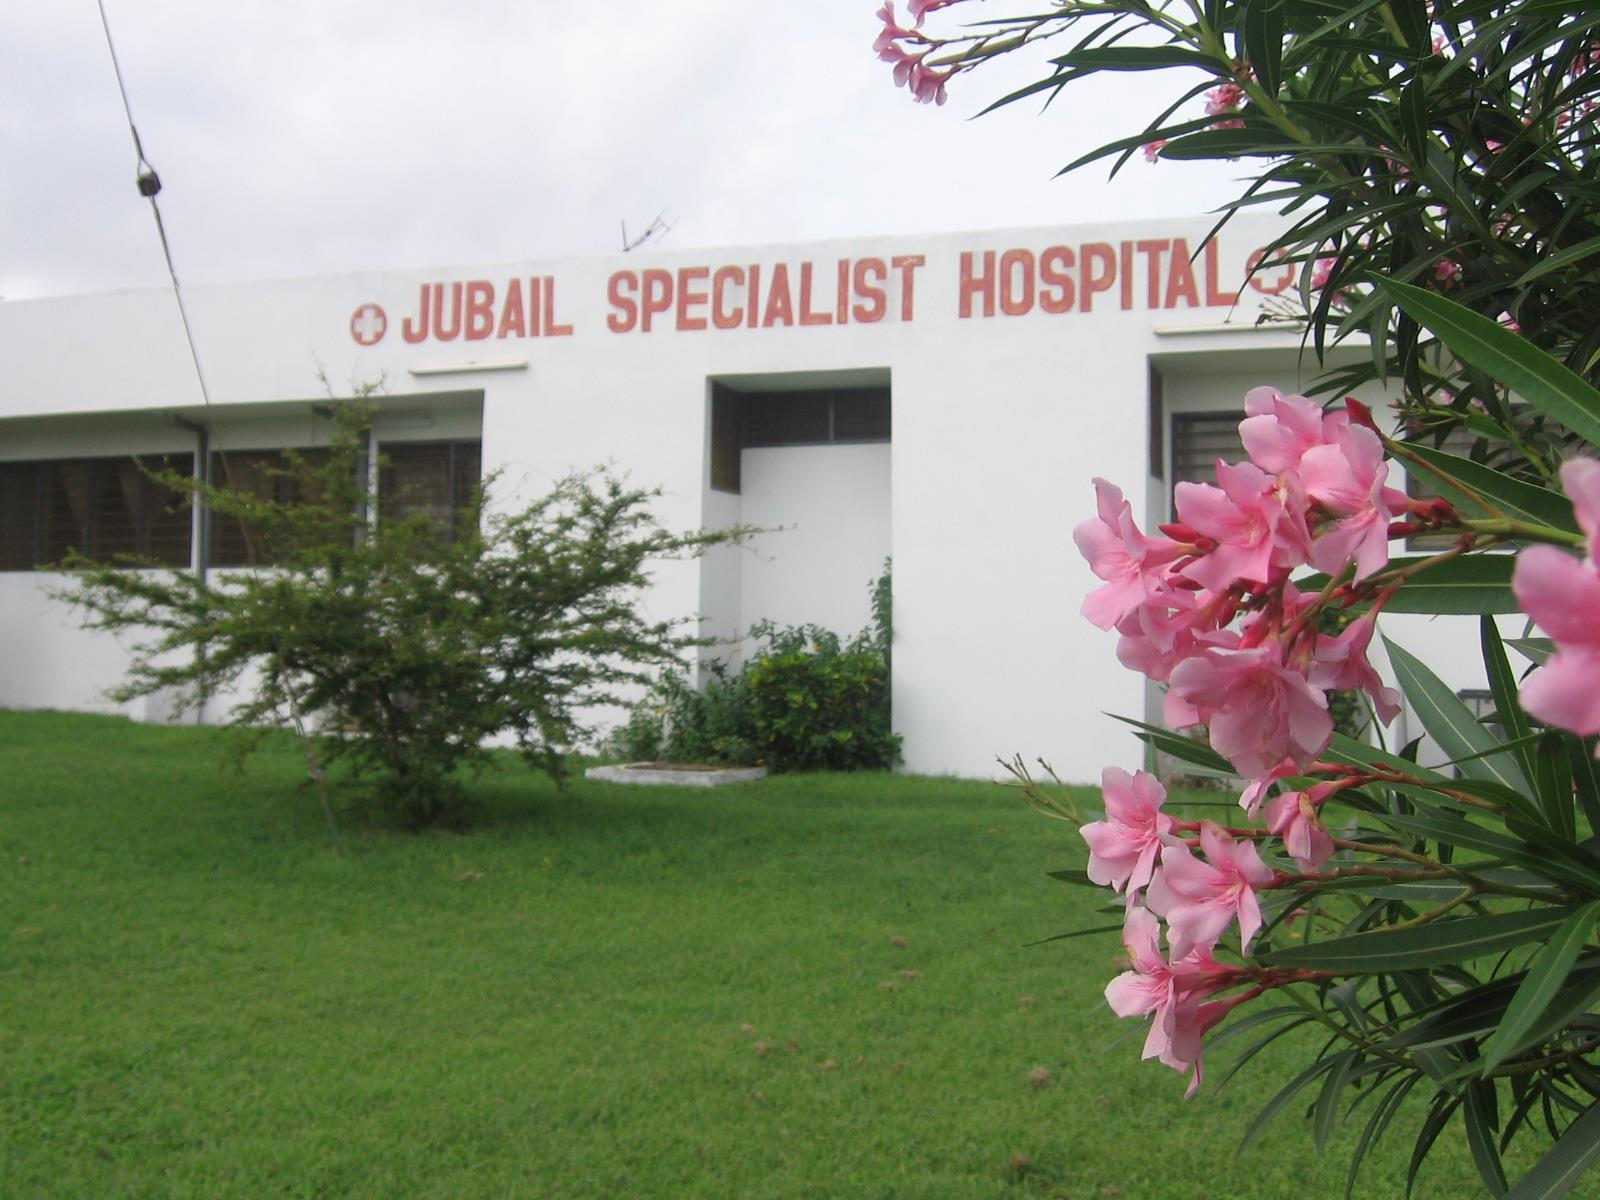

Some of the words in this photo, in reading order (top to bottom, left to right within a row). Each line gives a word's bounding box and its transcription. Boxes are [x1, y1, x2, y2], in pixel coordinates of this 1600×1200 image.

[403, 276, 574, 344] JUBAIL
[607, 255, 925, 334] SPECIALIST
[959, 237, 1239, 318] HOSPITAL
